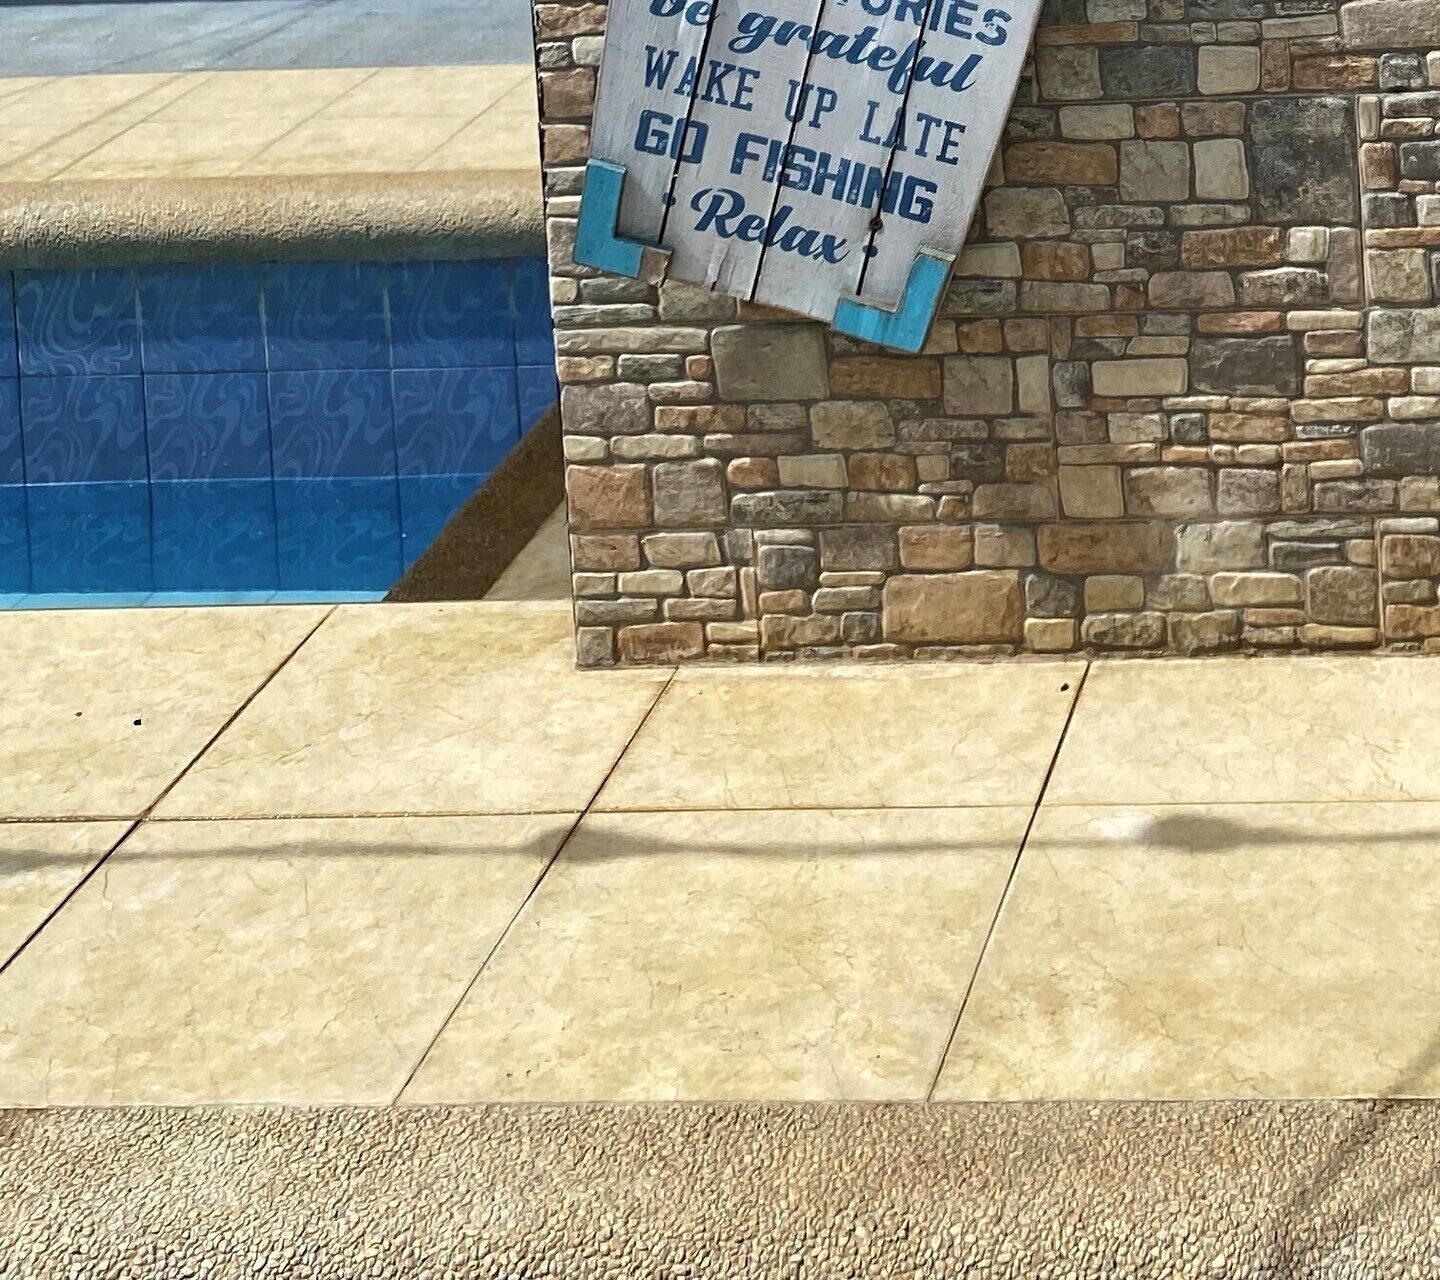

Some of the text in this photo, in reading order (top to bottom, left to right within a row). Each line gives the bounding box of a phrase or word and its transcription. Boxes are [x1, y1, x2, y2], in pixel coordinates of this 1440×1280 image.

[728, 10, 984, 95] grateful
[644, 45, 966, 165] WAKE UP LATE
[634, 109, 938, 224] GO FISHING
[690, 187, 850, 264] Relax
